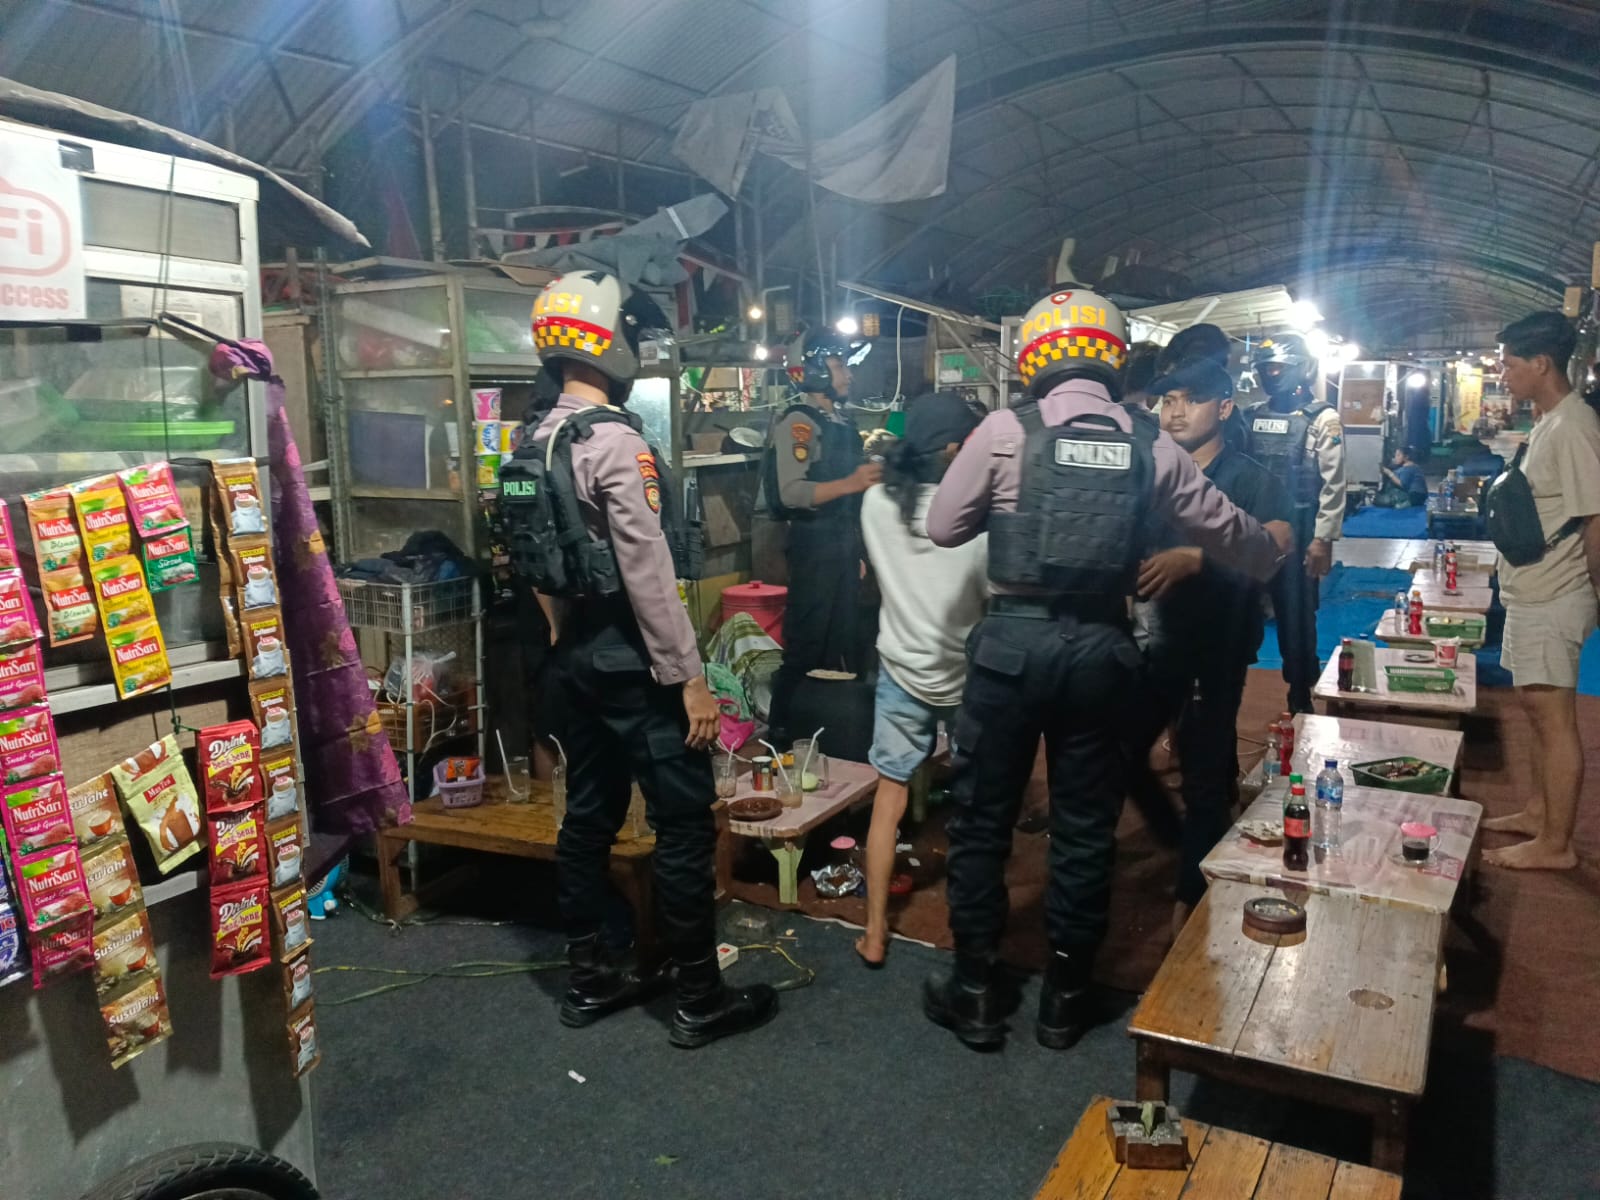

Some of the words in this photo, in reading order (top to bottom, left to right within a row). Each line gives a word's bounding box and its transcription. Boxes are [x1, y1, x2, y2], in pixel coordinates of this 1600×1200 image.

[0, 283, 70, 309] ccess
[1021, 304, 1106, 342] POLISI
[1059, 442, 1129, 466] POLISI
[503, 480, 536, 496] POLISI
[0, 659, 36, 678] triSari
[0, 730, 48, 752] NutriSari
[208, 732, 247, 760] Drink
[12, 800, 63, 823] NutriSari
[28, 869, 78, 894] NutriSari
[219, 893, 258, 923] Drink
